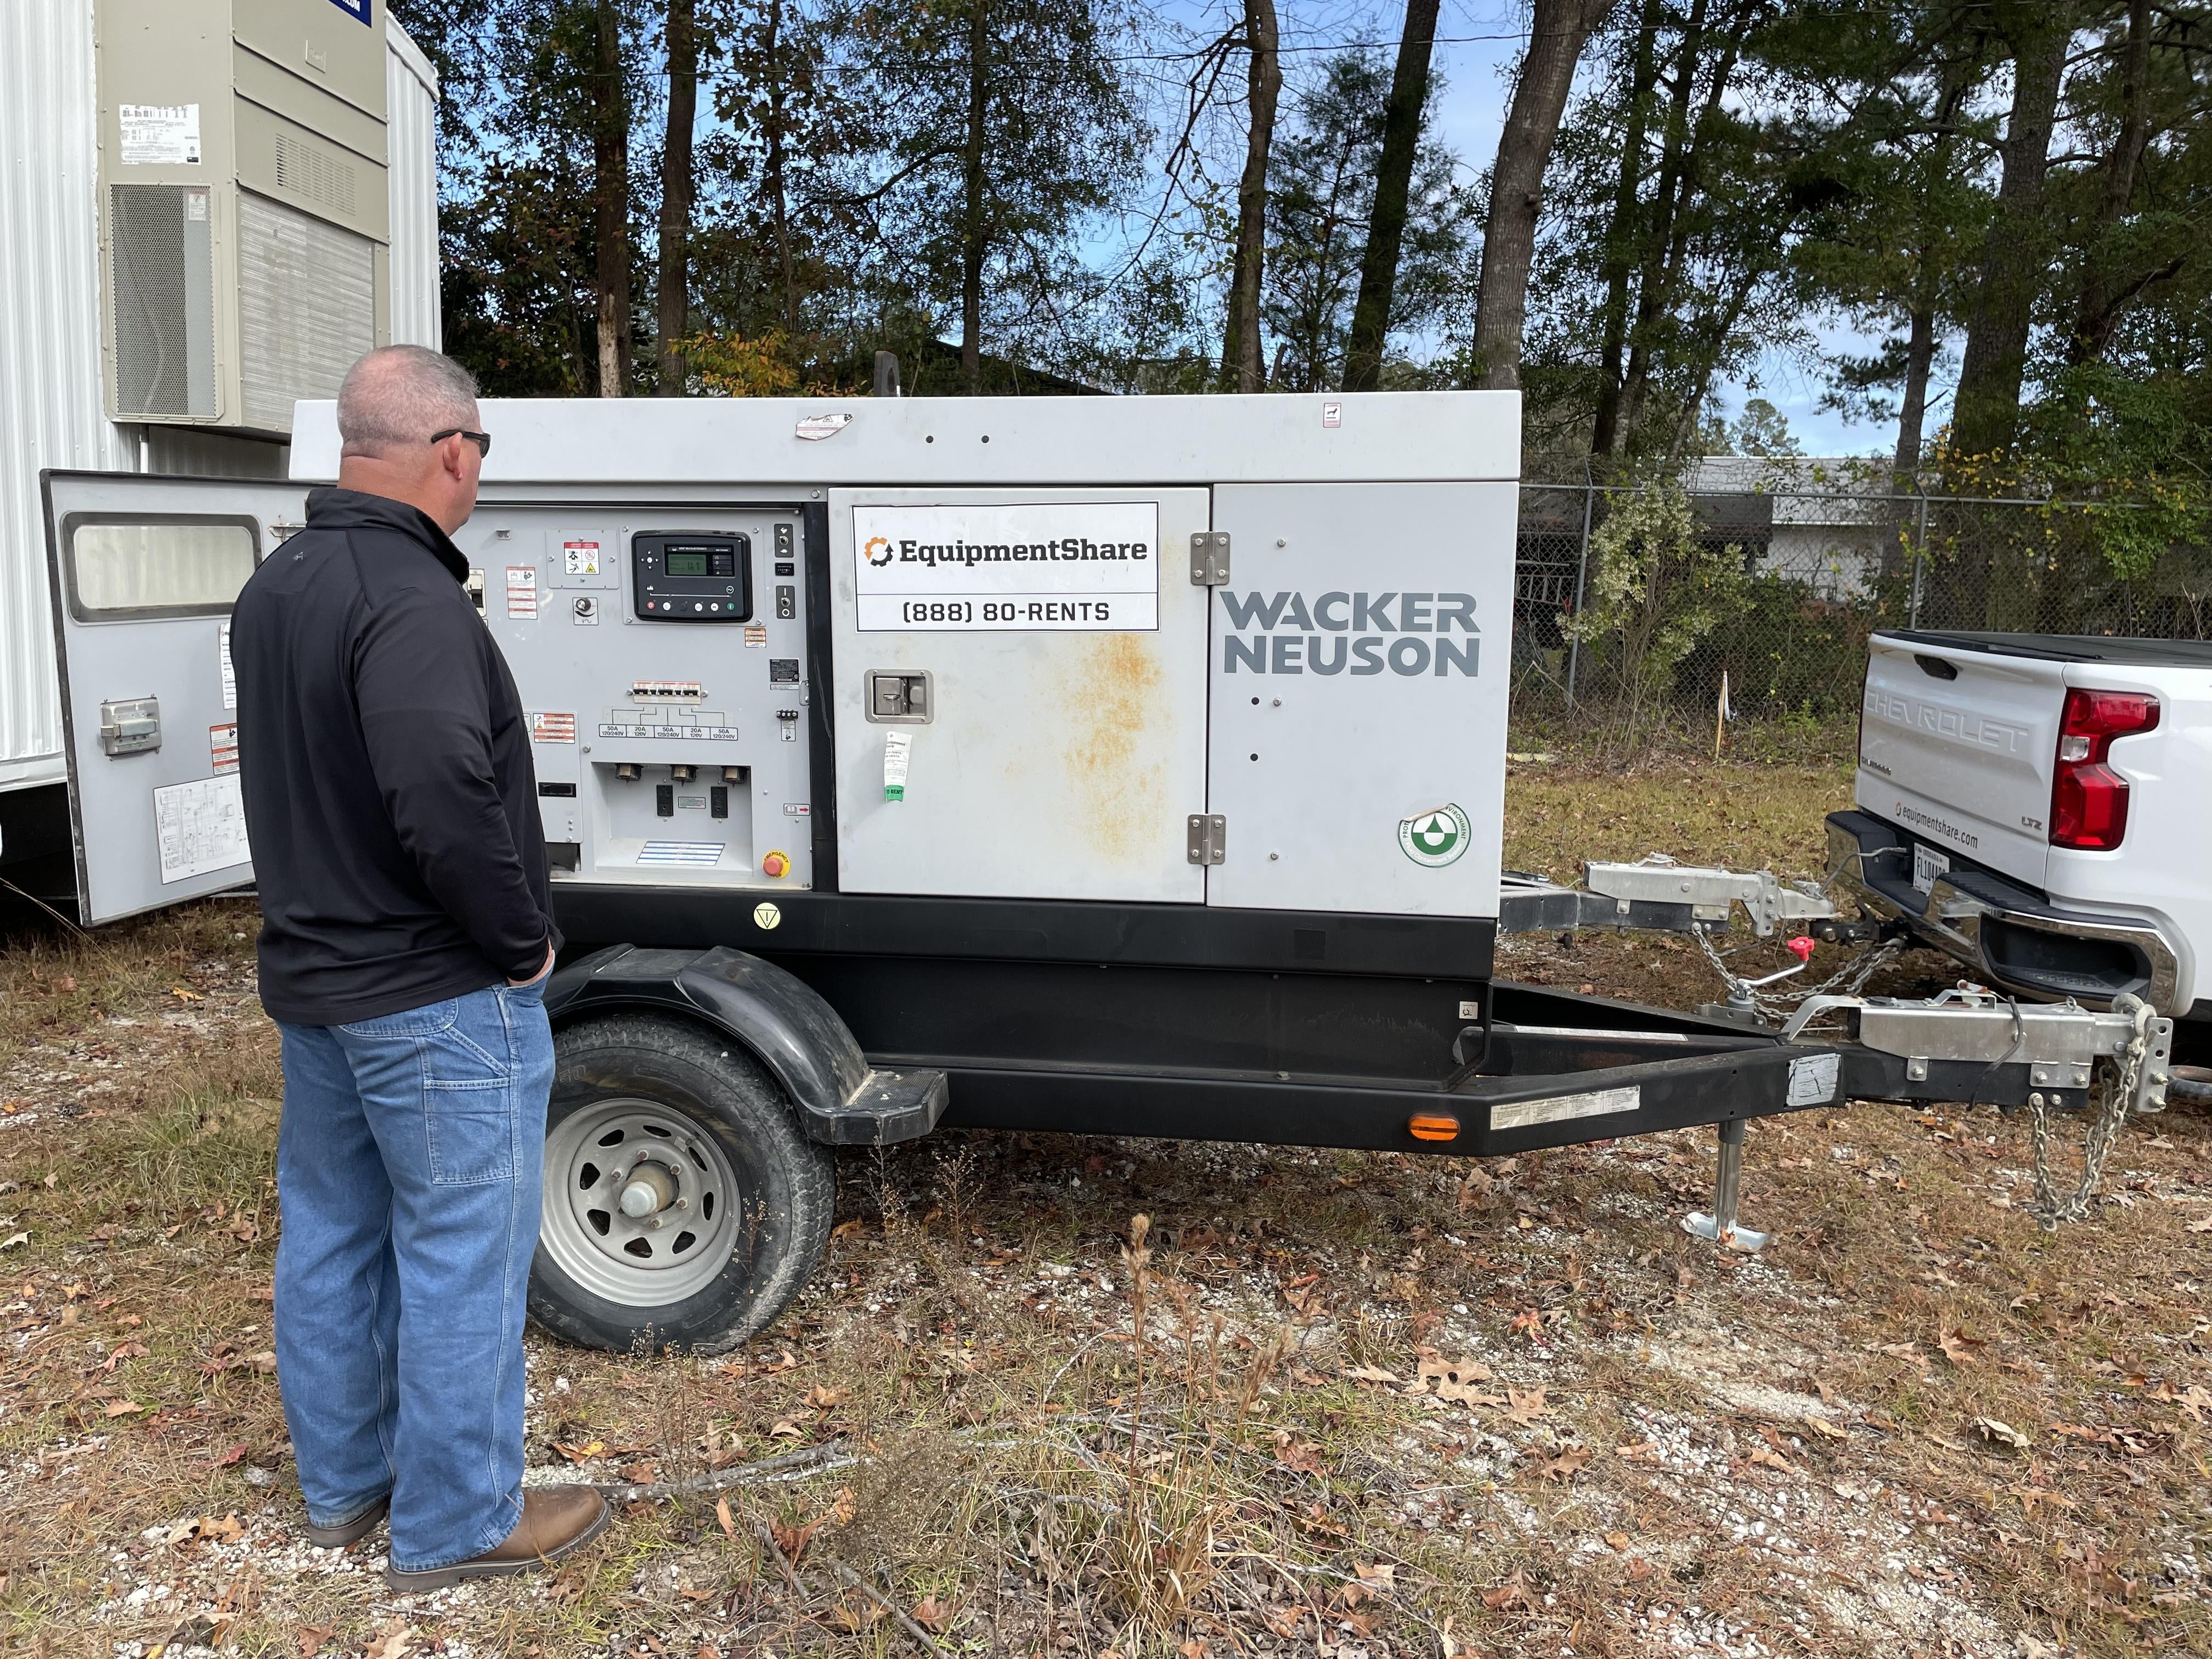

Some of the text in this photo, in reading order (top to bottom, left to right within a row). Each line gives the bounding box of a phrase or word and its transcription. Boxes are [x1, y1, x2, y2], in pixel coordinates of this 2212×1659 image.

[900, 539, 1147, 566] EquipmentShare
[904, 602, 1108, 623] (888) 80-RENTS
[1220, 591, 1481, 632] WACKER
[1224, 635, 1480, 676] NEUSON
[1865, 689, 2029, 752] CHEVROLET
[1903, 805, 1978, 849] equipmentshare.com
